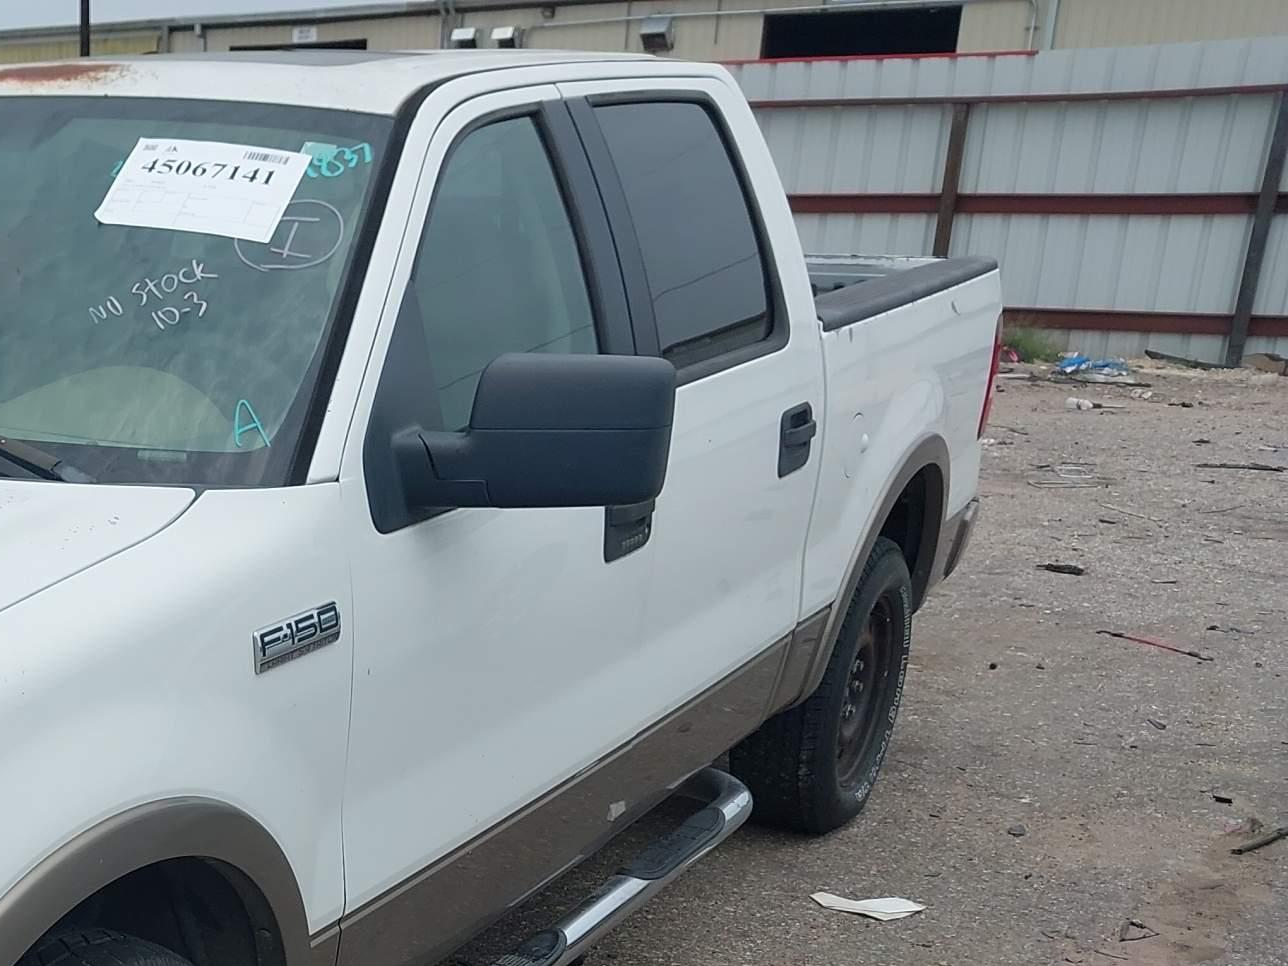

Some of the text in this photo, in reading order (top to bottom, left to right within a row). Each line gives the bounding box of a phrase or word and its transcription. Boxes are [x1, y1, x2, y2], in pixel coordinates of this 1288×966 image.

[141, 158, 276, 186] 45067141
[151, 290, 208, 331] 10-3
[232, 399, 271, 449] A
[259, 604, 340, 658] F-150
